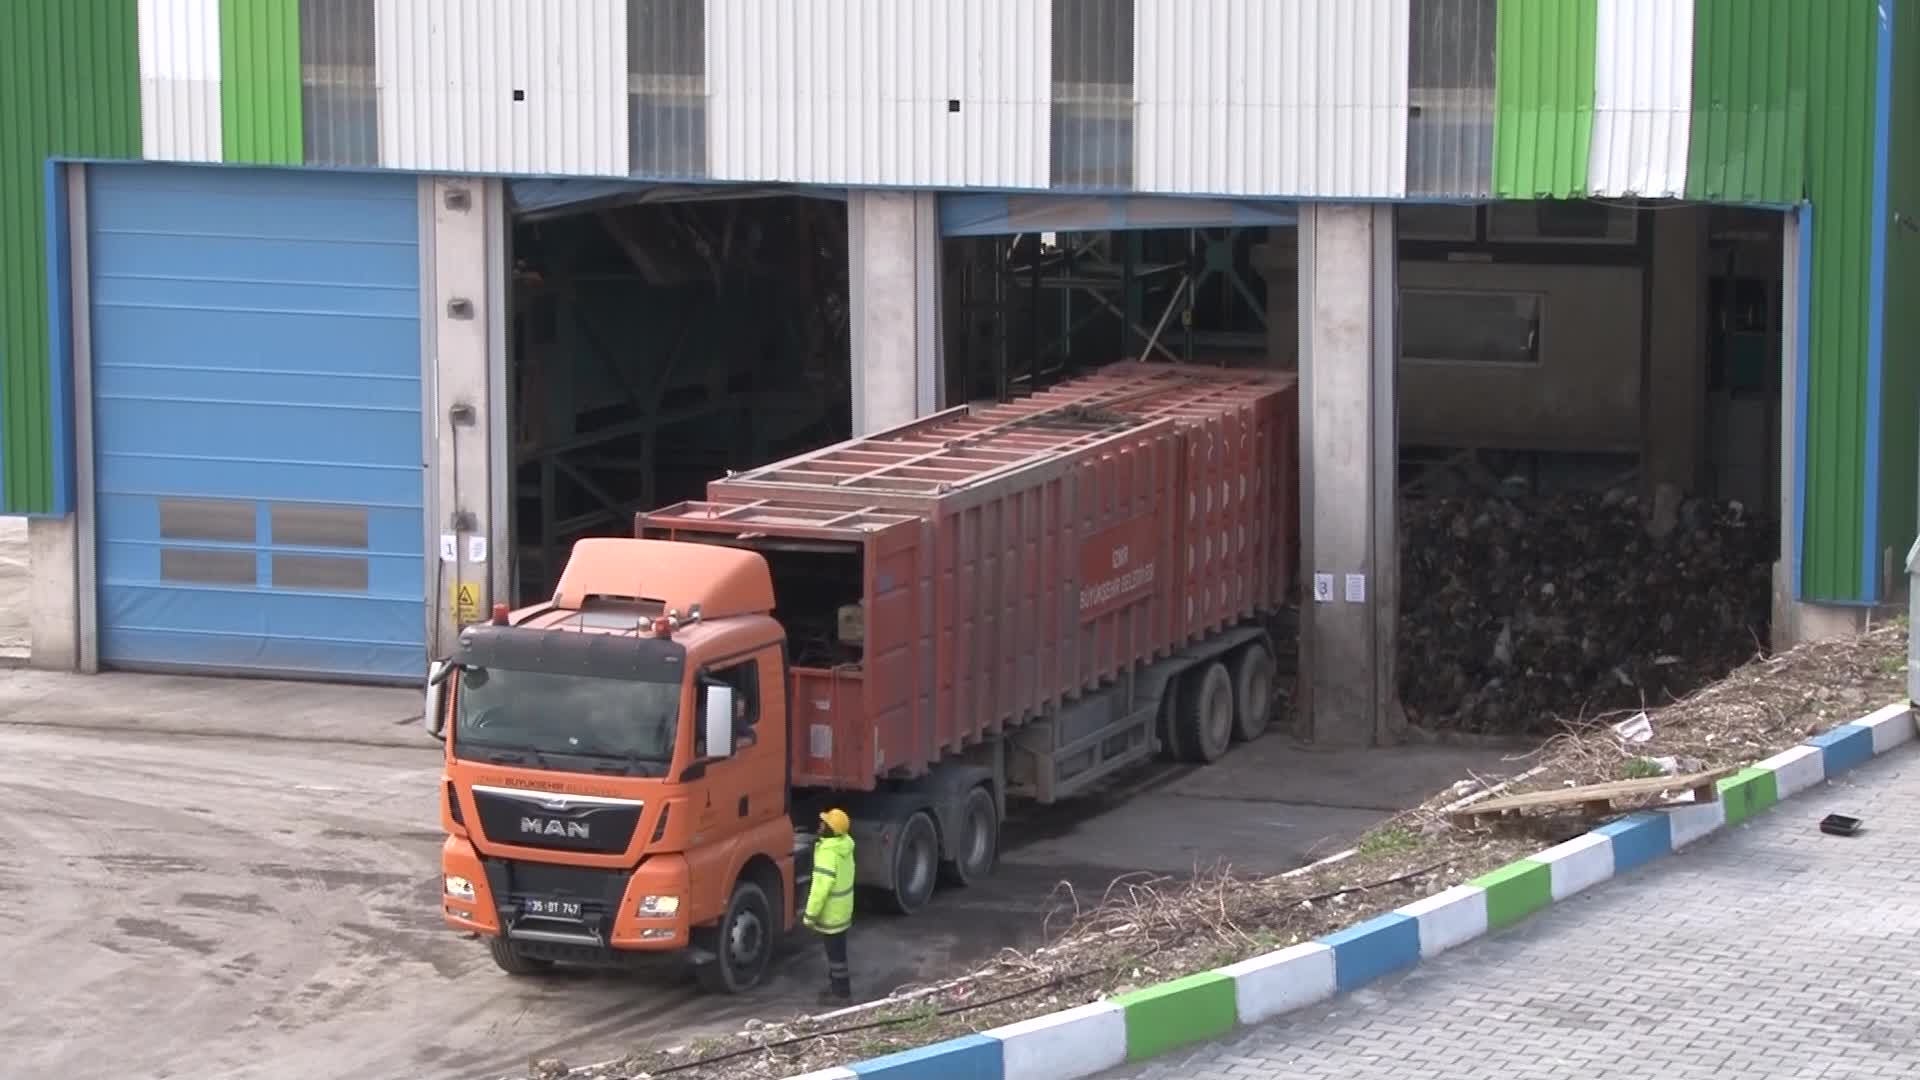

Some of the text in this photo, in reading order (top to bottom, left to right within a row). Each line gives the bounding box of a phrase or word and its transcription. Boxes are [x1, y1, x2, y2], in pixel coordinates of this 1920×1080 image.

[1319, 581, 1328, 595] 3
[520, 816, 591, 839] MAN
[532, 900, 543, 912] 35
[562, 902, 579, 915] 747
